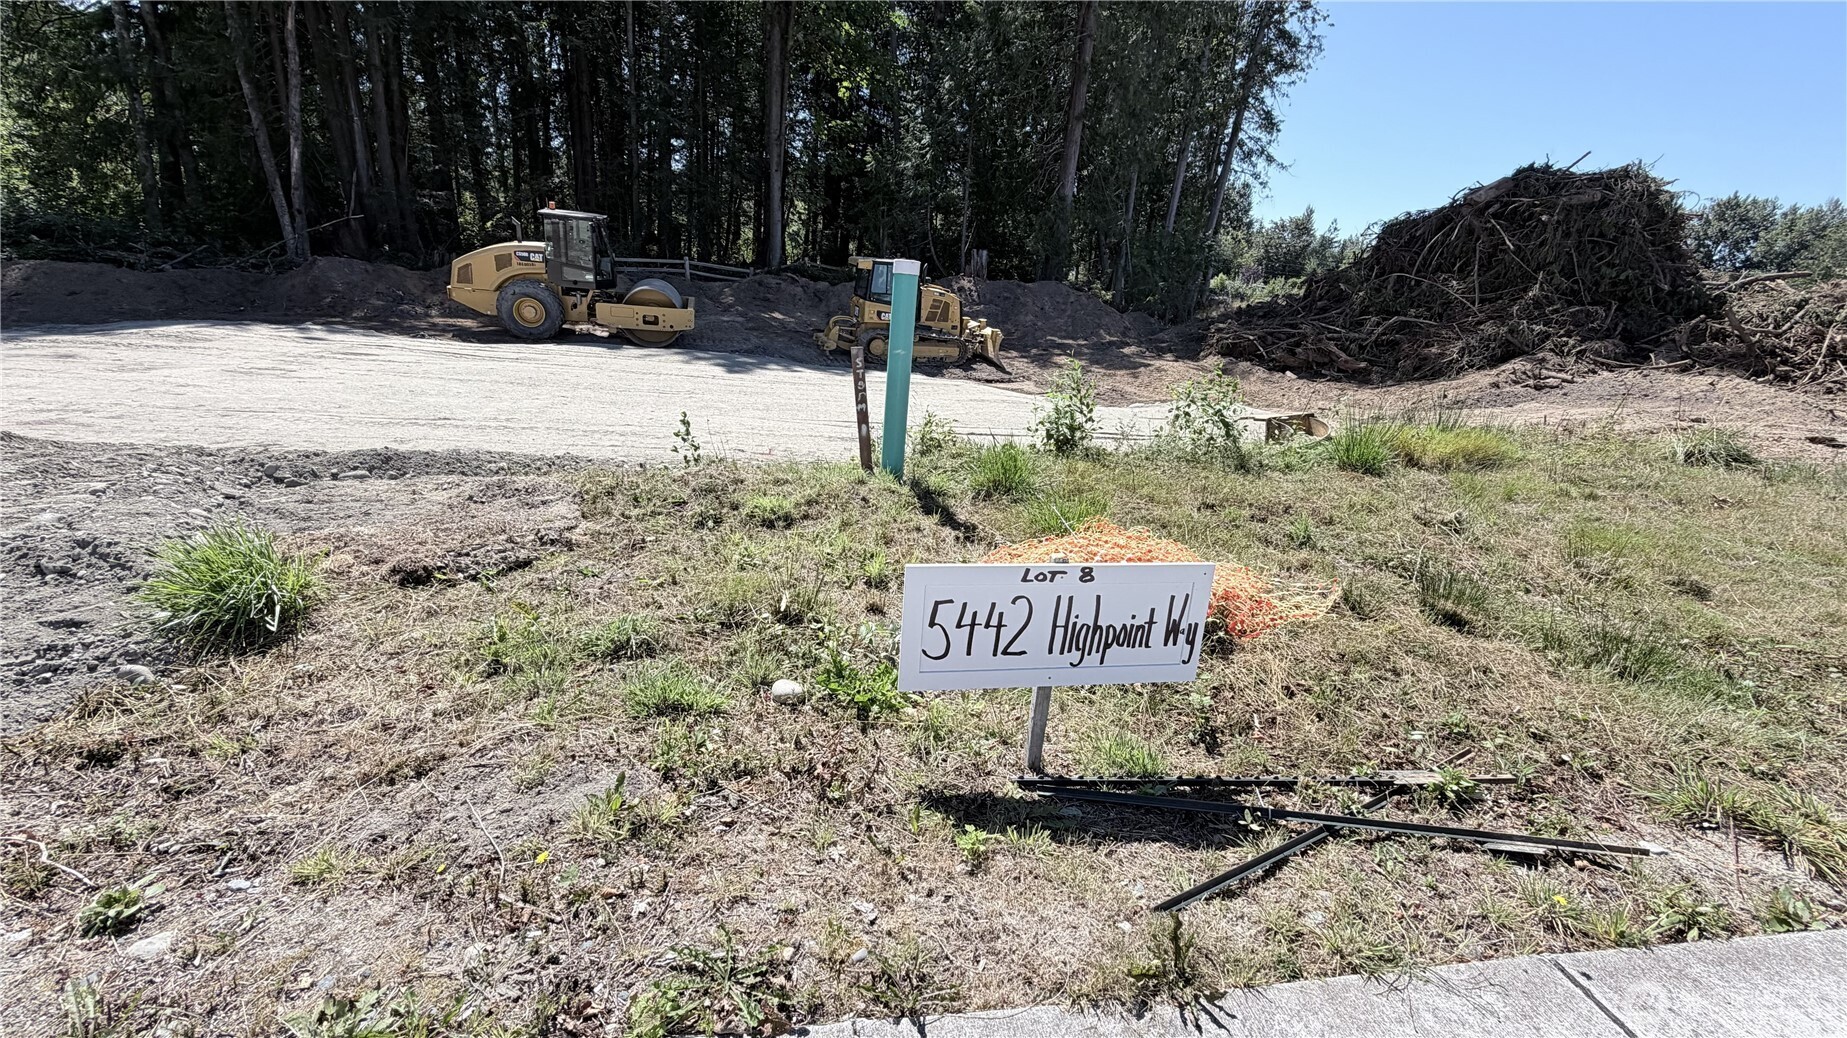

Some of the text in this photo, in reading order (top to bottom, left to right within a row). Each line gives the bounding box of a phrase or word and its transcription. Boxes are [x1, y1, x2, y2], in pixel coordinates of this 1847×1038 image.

[530, 252, 543, 261] CAT
[1078, 566, 1095, 583] 8
[921, 595, 1034, 660] 5442
[1047, 594, 1158, 667] Highpoint
